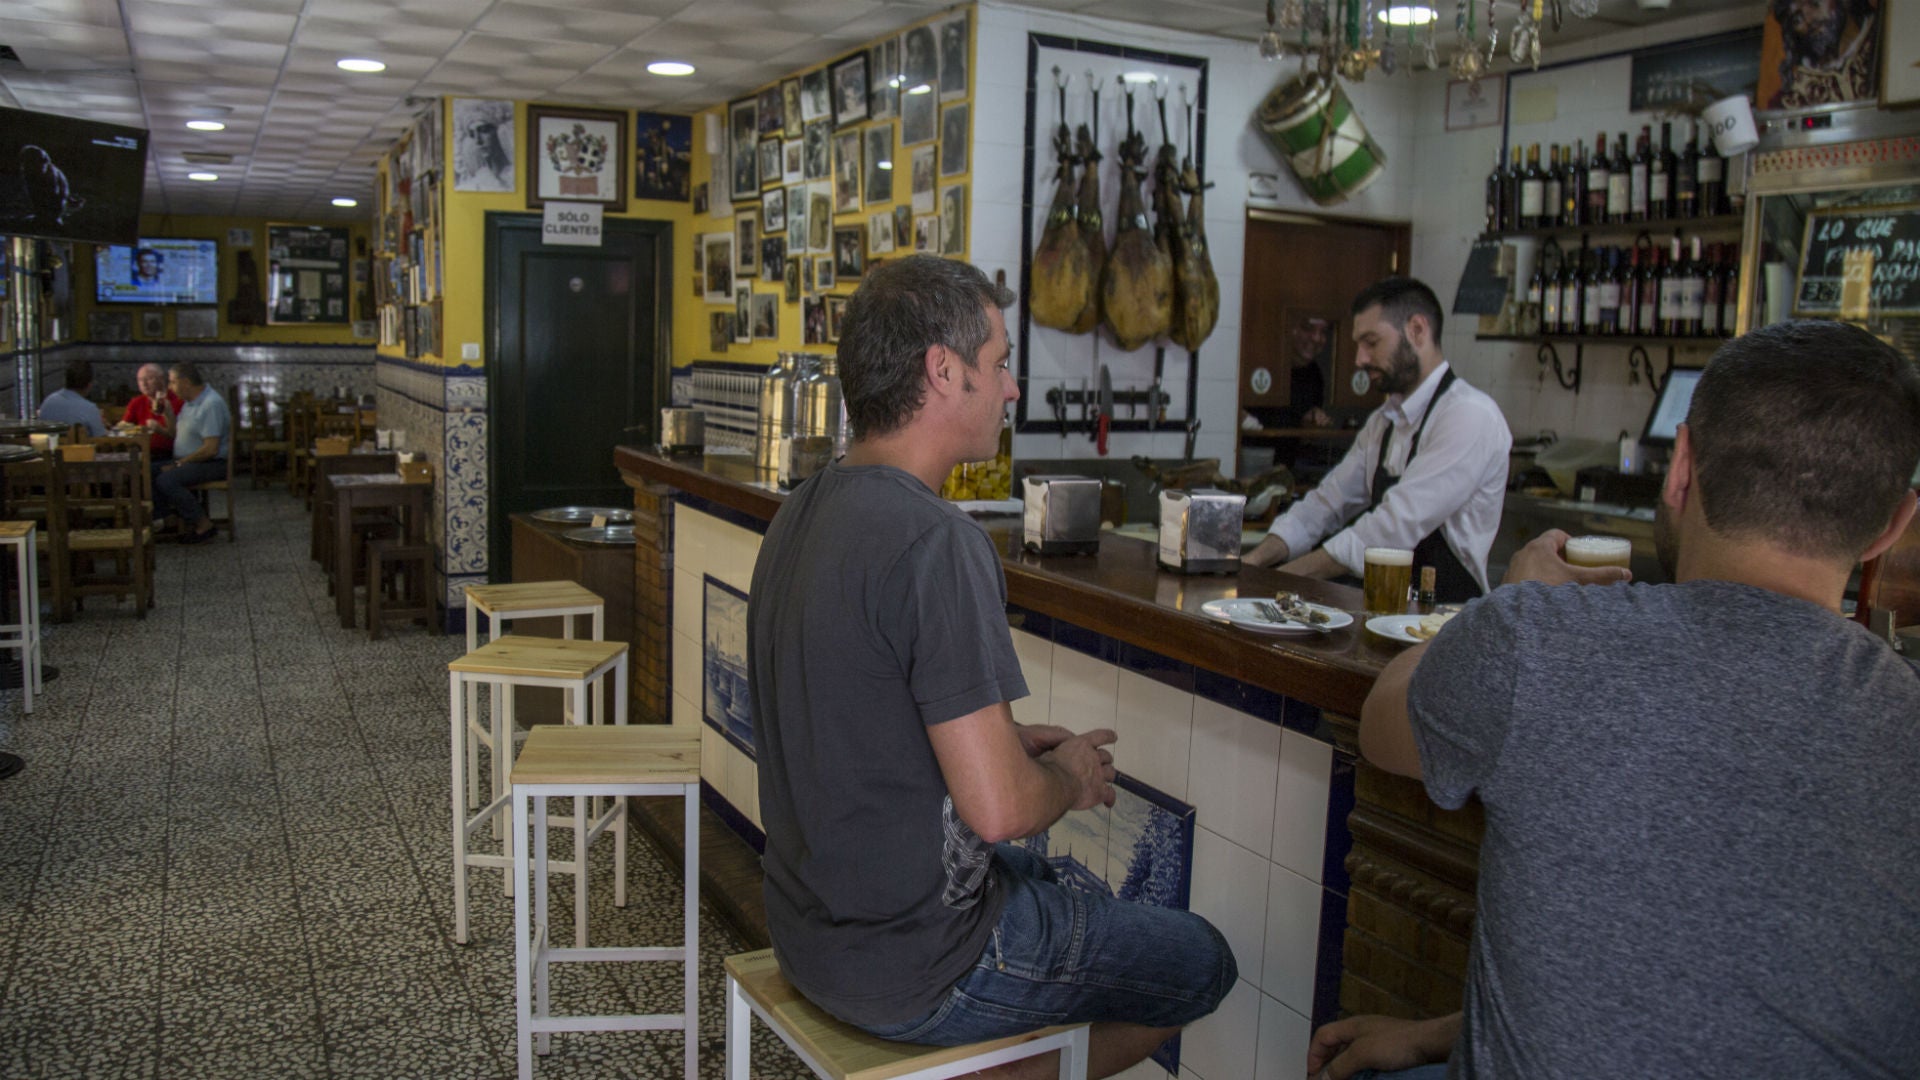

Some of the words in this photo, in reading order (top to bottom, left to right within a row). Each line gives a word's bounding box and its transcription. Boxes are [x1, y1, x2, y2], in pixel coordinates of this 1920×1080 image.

[558, 211, 590, 222] SÓLO
[545, 224, 599, 235] CLIENTES
[1818, 220, 1844, 240] LO
[1855, 218, 1897, 239] QUE
